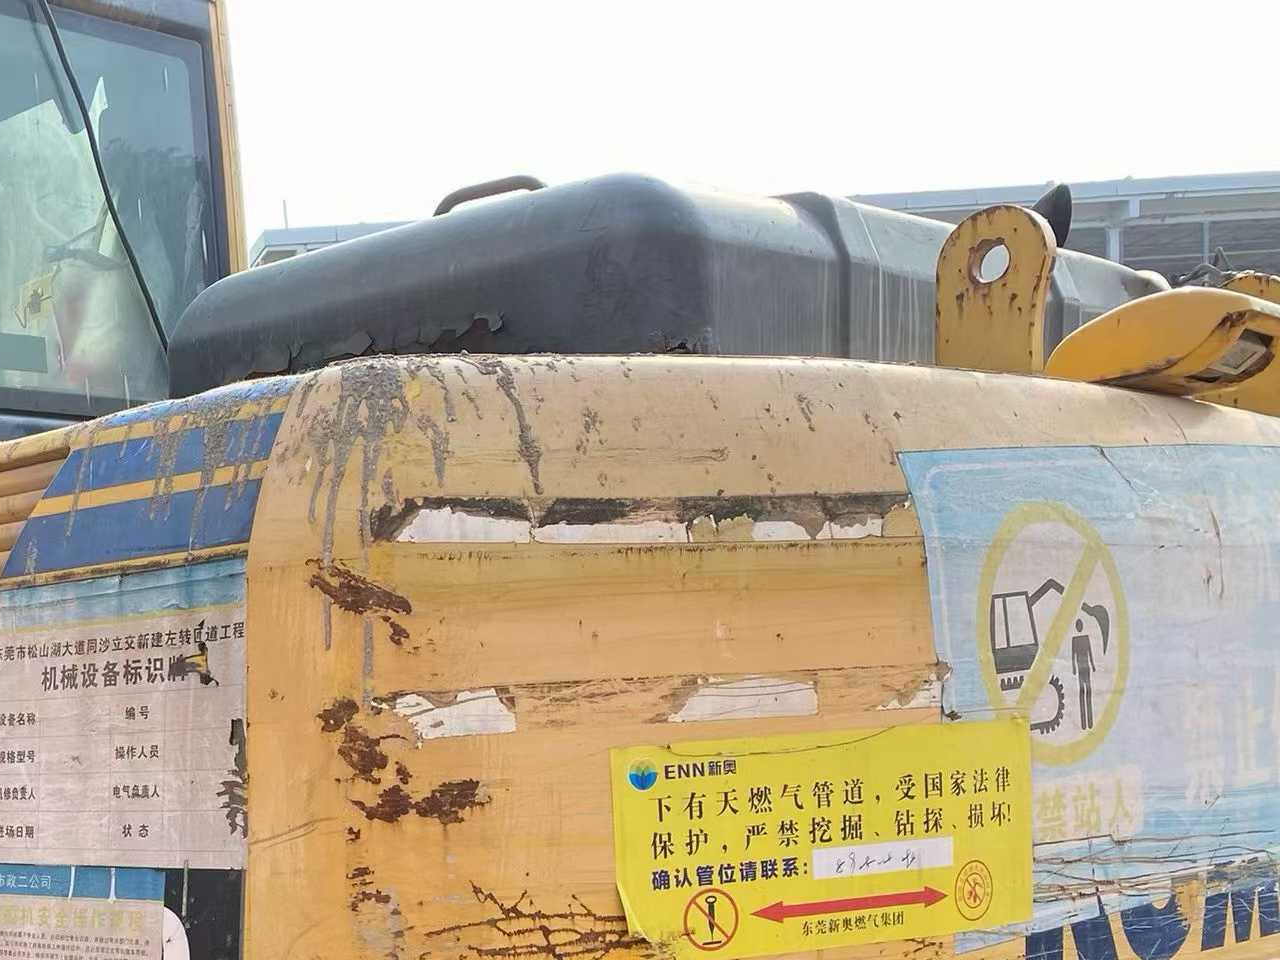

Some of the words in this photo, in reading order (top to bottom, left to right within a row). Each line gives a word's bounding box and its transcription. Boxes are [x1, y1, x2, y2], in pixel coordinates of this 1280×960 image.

[115, 745, 160, 760] 操作人员
[650, 765, 1012, 824] 下有天燃气管道，受国家法律
[800, 910, 905, 937] 东莞新奥燃气集团
